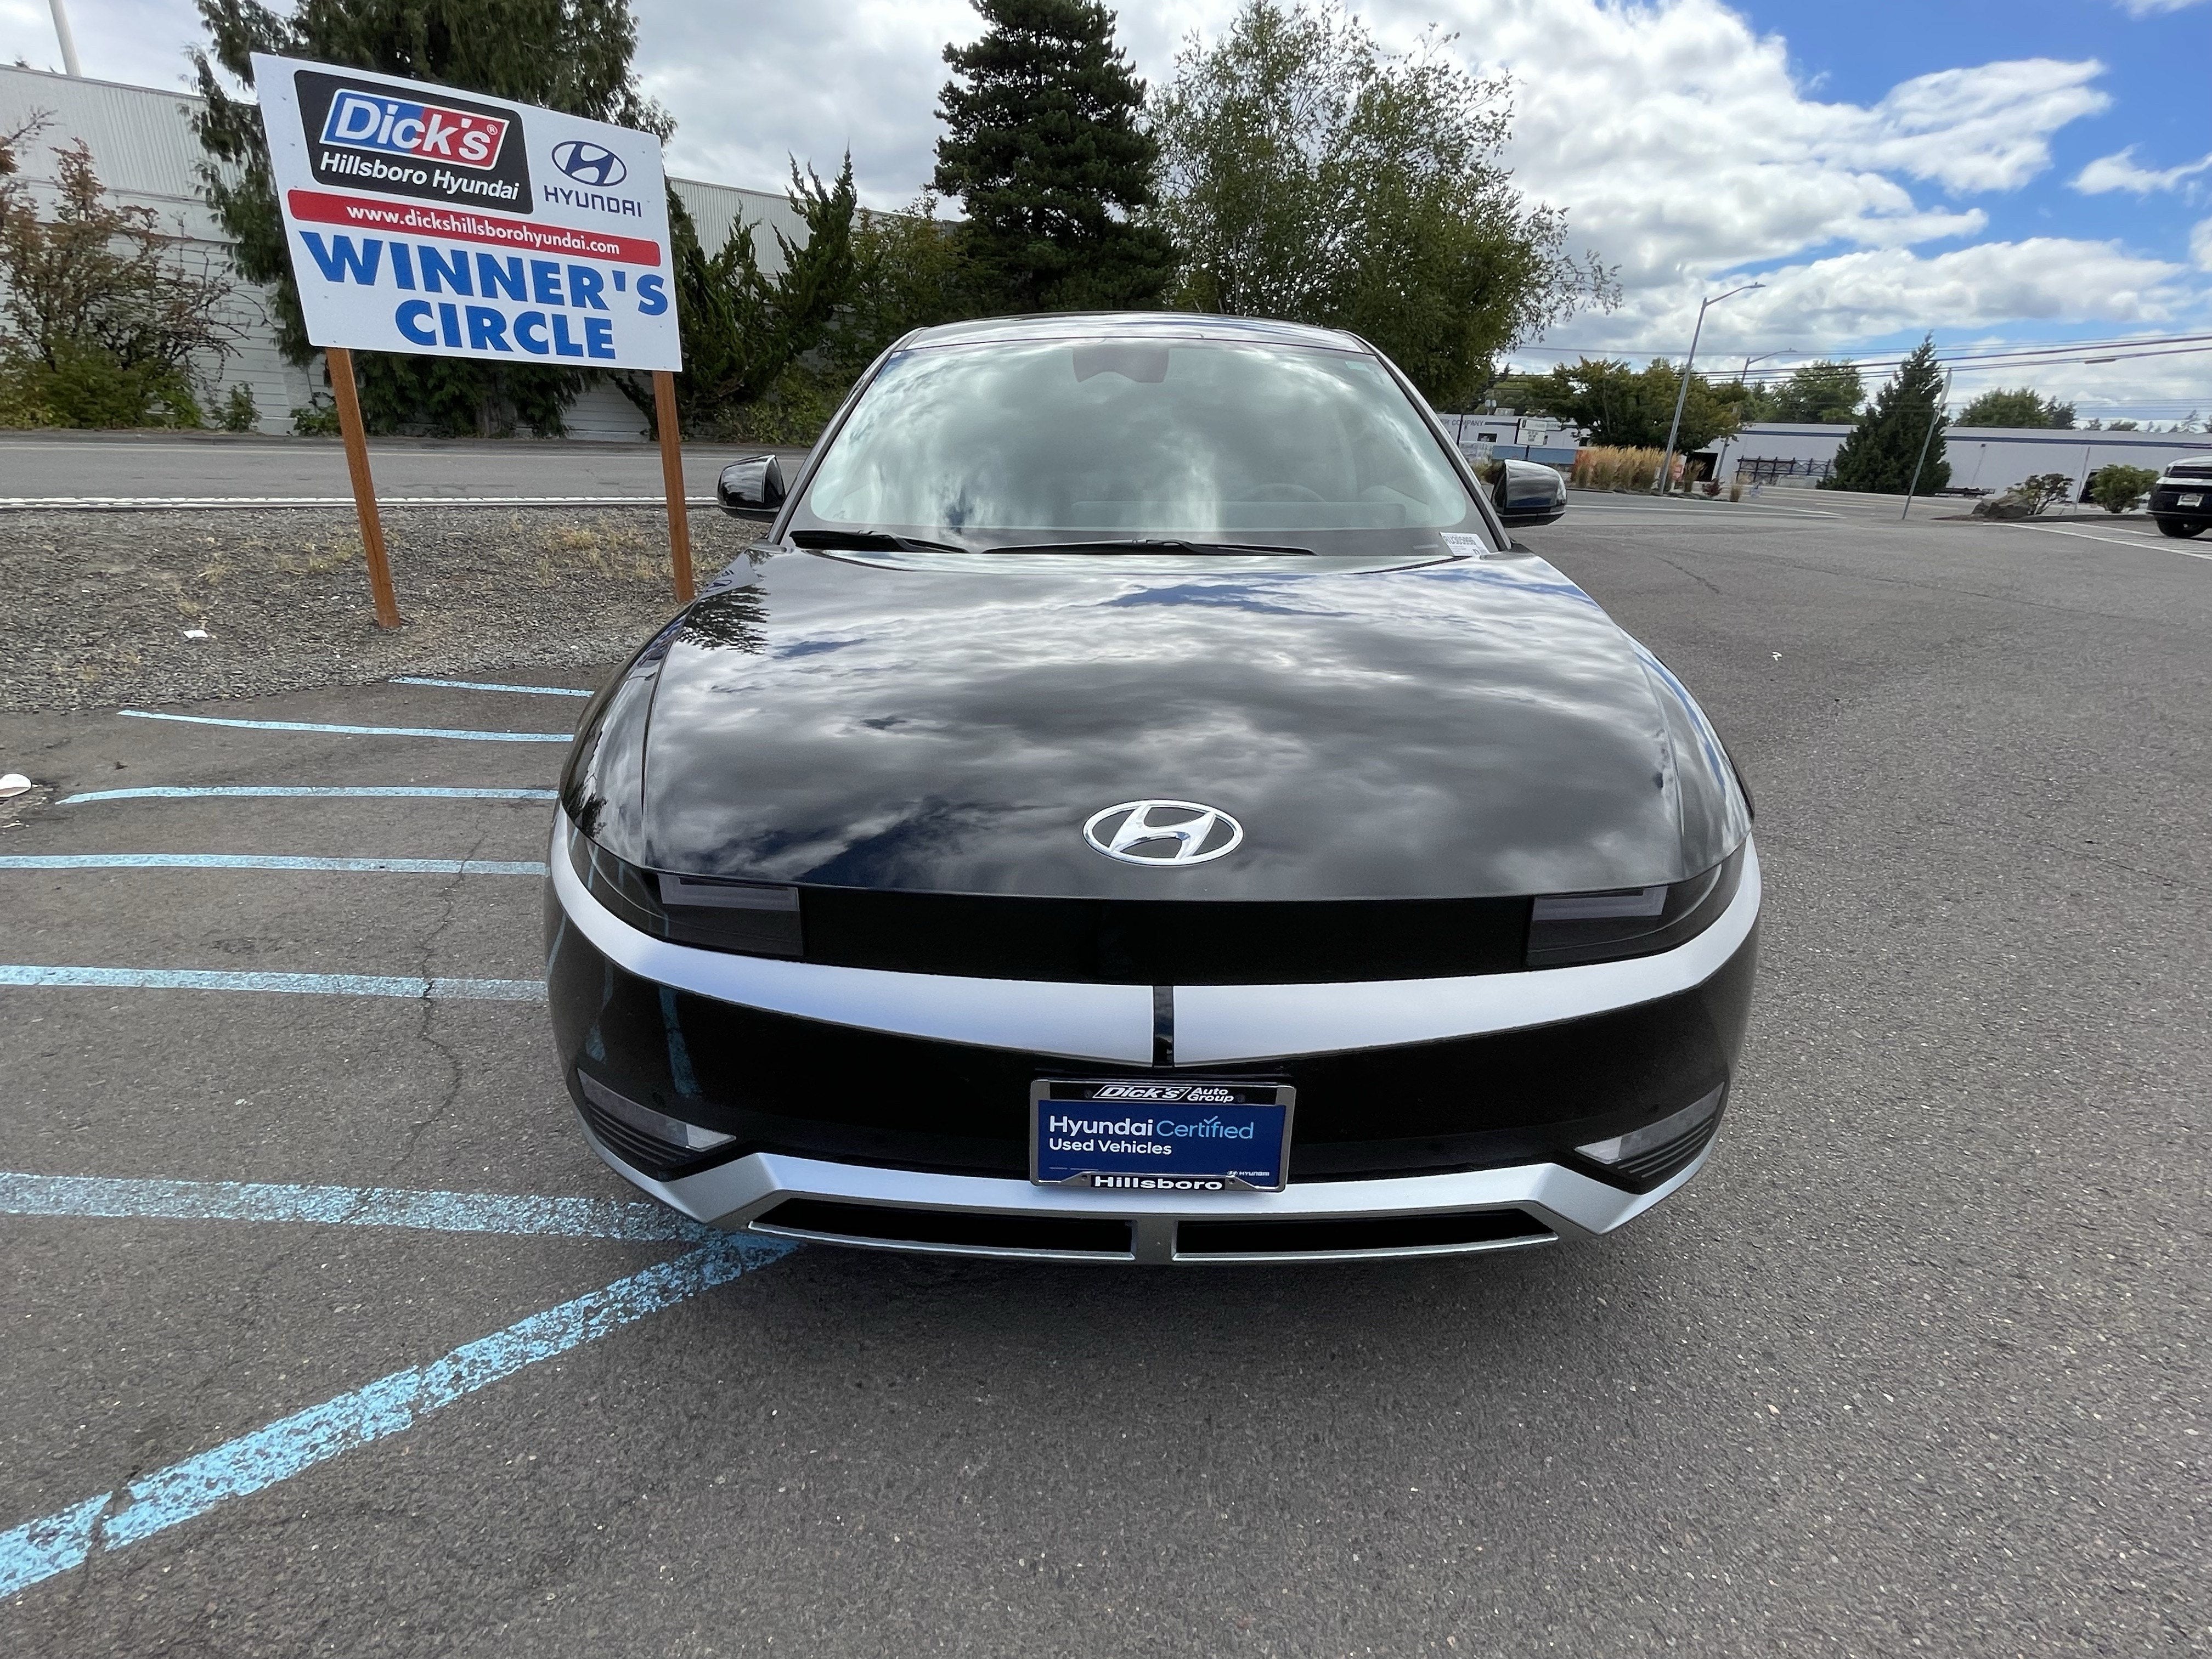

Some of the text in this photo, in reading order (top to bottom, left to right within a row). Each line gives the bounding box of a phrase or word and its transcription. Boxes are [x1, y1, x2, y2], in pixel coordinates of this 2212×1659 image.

[335, 97, 492, 161] Dick's
[320, 152, 520, 201] Hillsboro Hyundai
[544, 185, 642, 218] HYUNDAI
[346, 204, 620, 255] www.dickshillsborohyundai.com
[298, 230, 669, 316] WINNER'S
[395, 300, 616, 360] CIRCLE
[1100, 1086, 1180, 1099] Dick's
[1187, 1093, 1234, 1103] Group
[1190, 1087, 1229, 1096] Auto
[1049, 1115, 1254, 1139] Hyundai Certified
[1049, 1138, 1172, 1155] Used Vehicles
[1094, 1176, 1223, 1190] Hillsboro
